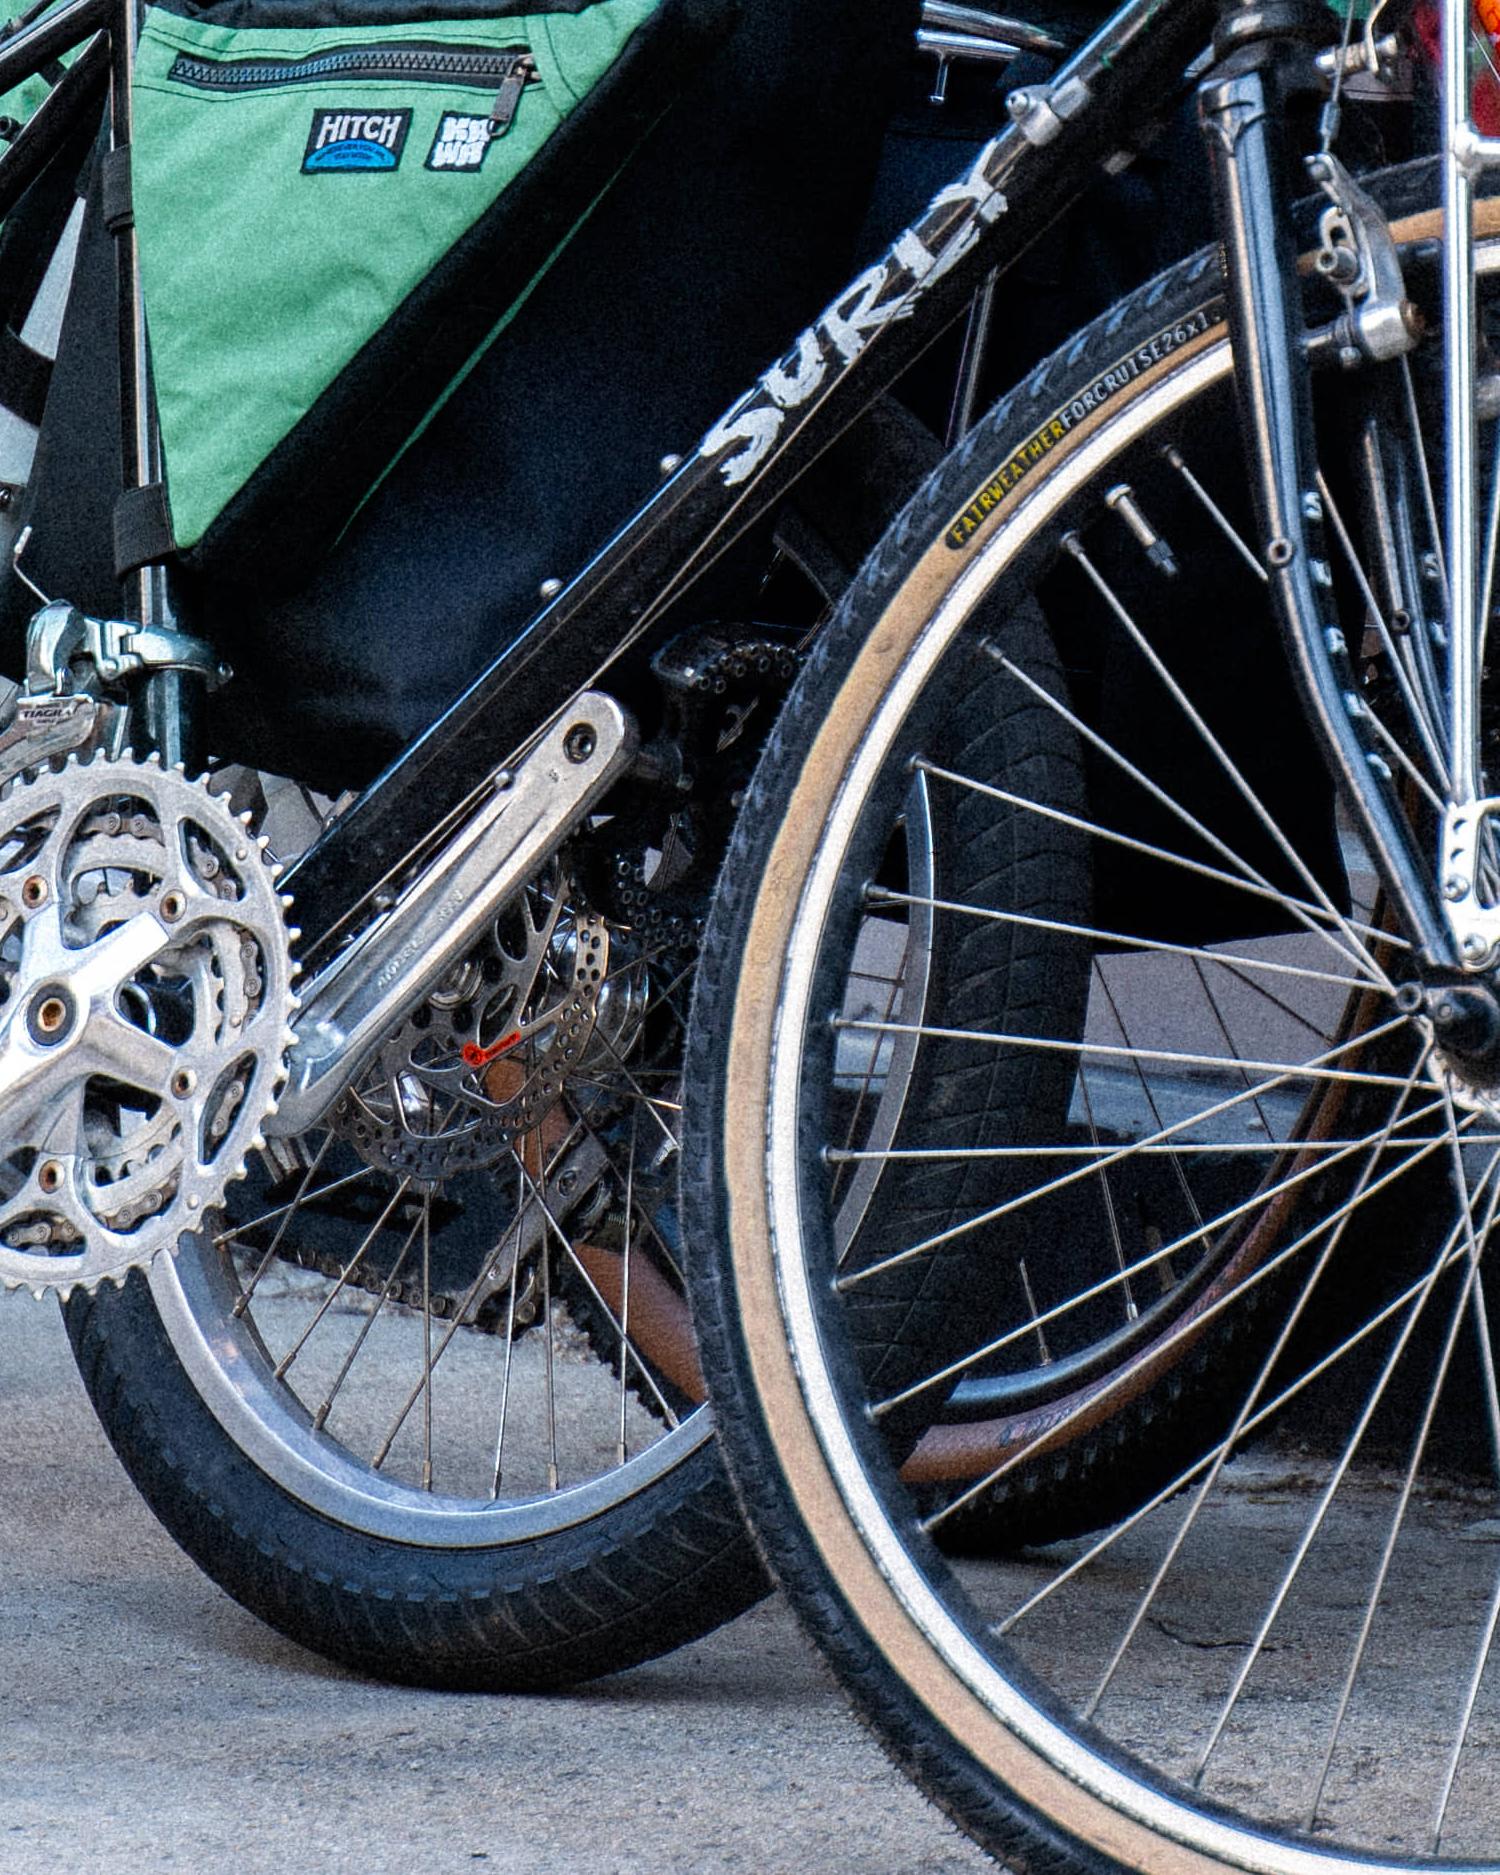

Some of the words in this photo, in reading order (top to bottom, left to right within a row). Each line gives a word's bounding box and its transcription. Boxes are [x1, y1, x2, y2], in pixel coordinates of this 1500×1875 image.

[315, 115, 402, 149] HITCH
[699, 136, 1009, 488] SURLY
[951, 420, 1066, 544] FAIRWEATHER
